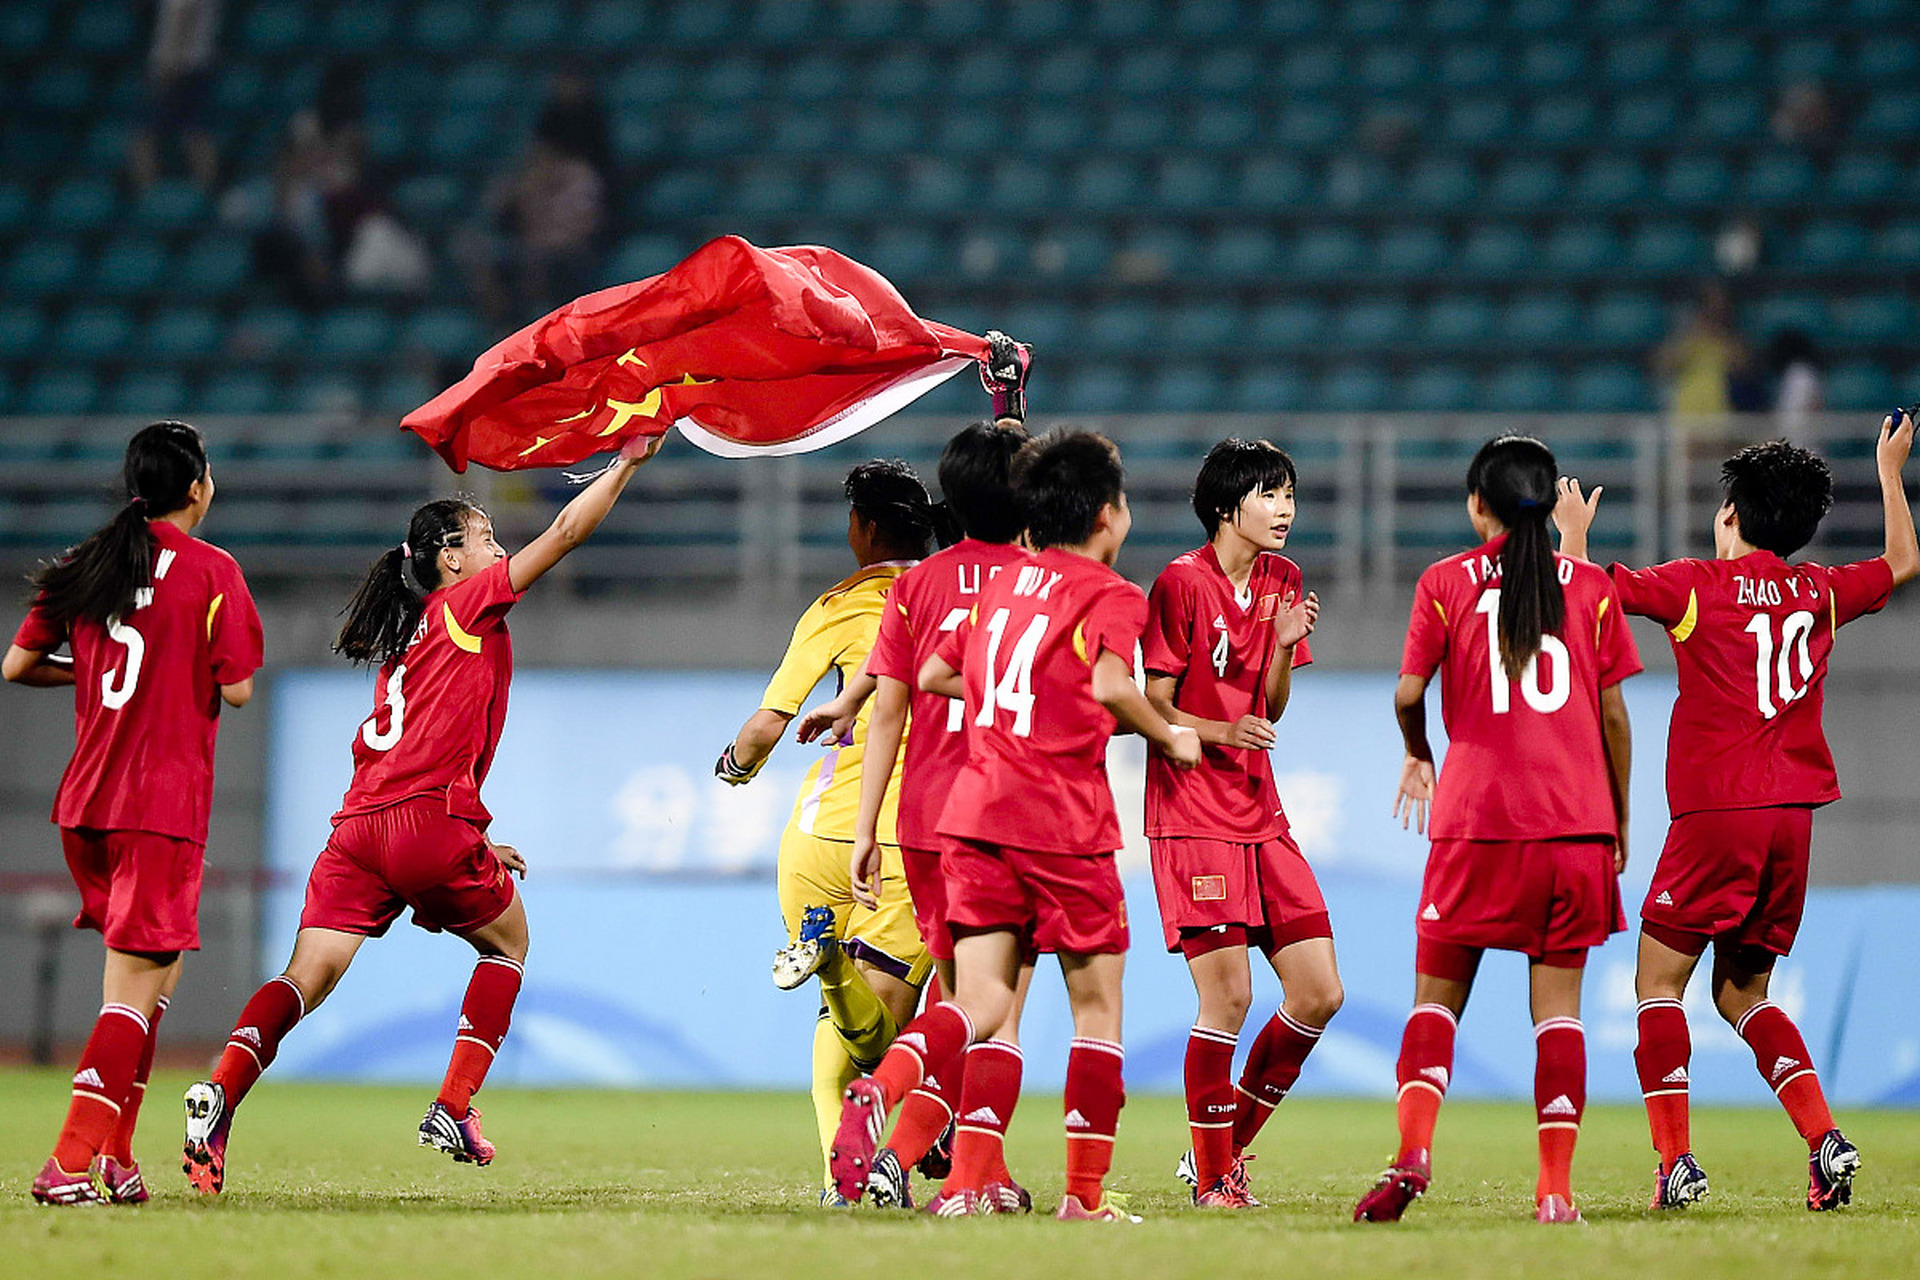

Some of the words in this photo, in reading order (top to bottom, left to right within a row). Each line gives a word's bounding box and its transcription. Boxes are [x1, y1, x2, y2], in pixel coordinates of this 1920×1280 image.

[1461, 554, 1503, 585] TA
[1733, 575, 1783, 606] ZHAO
[1785, 576, 1800, 599] Y
[102, 614, 145, 710] 5
[974, 607, 1051, 738] 14
[1212, 630, 1228, 678] 4
[1474, 588, 1572, 714] 16
[1744, 611, 1815, 720] 10
[361, 663, 406, 752] 3
